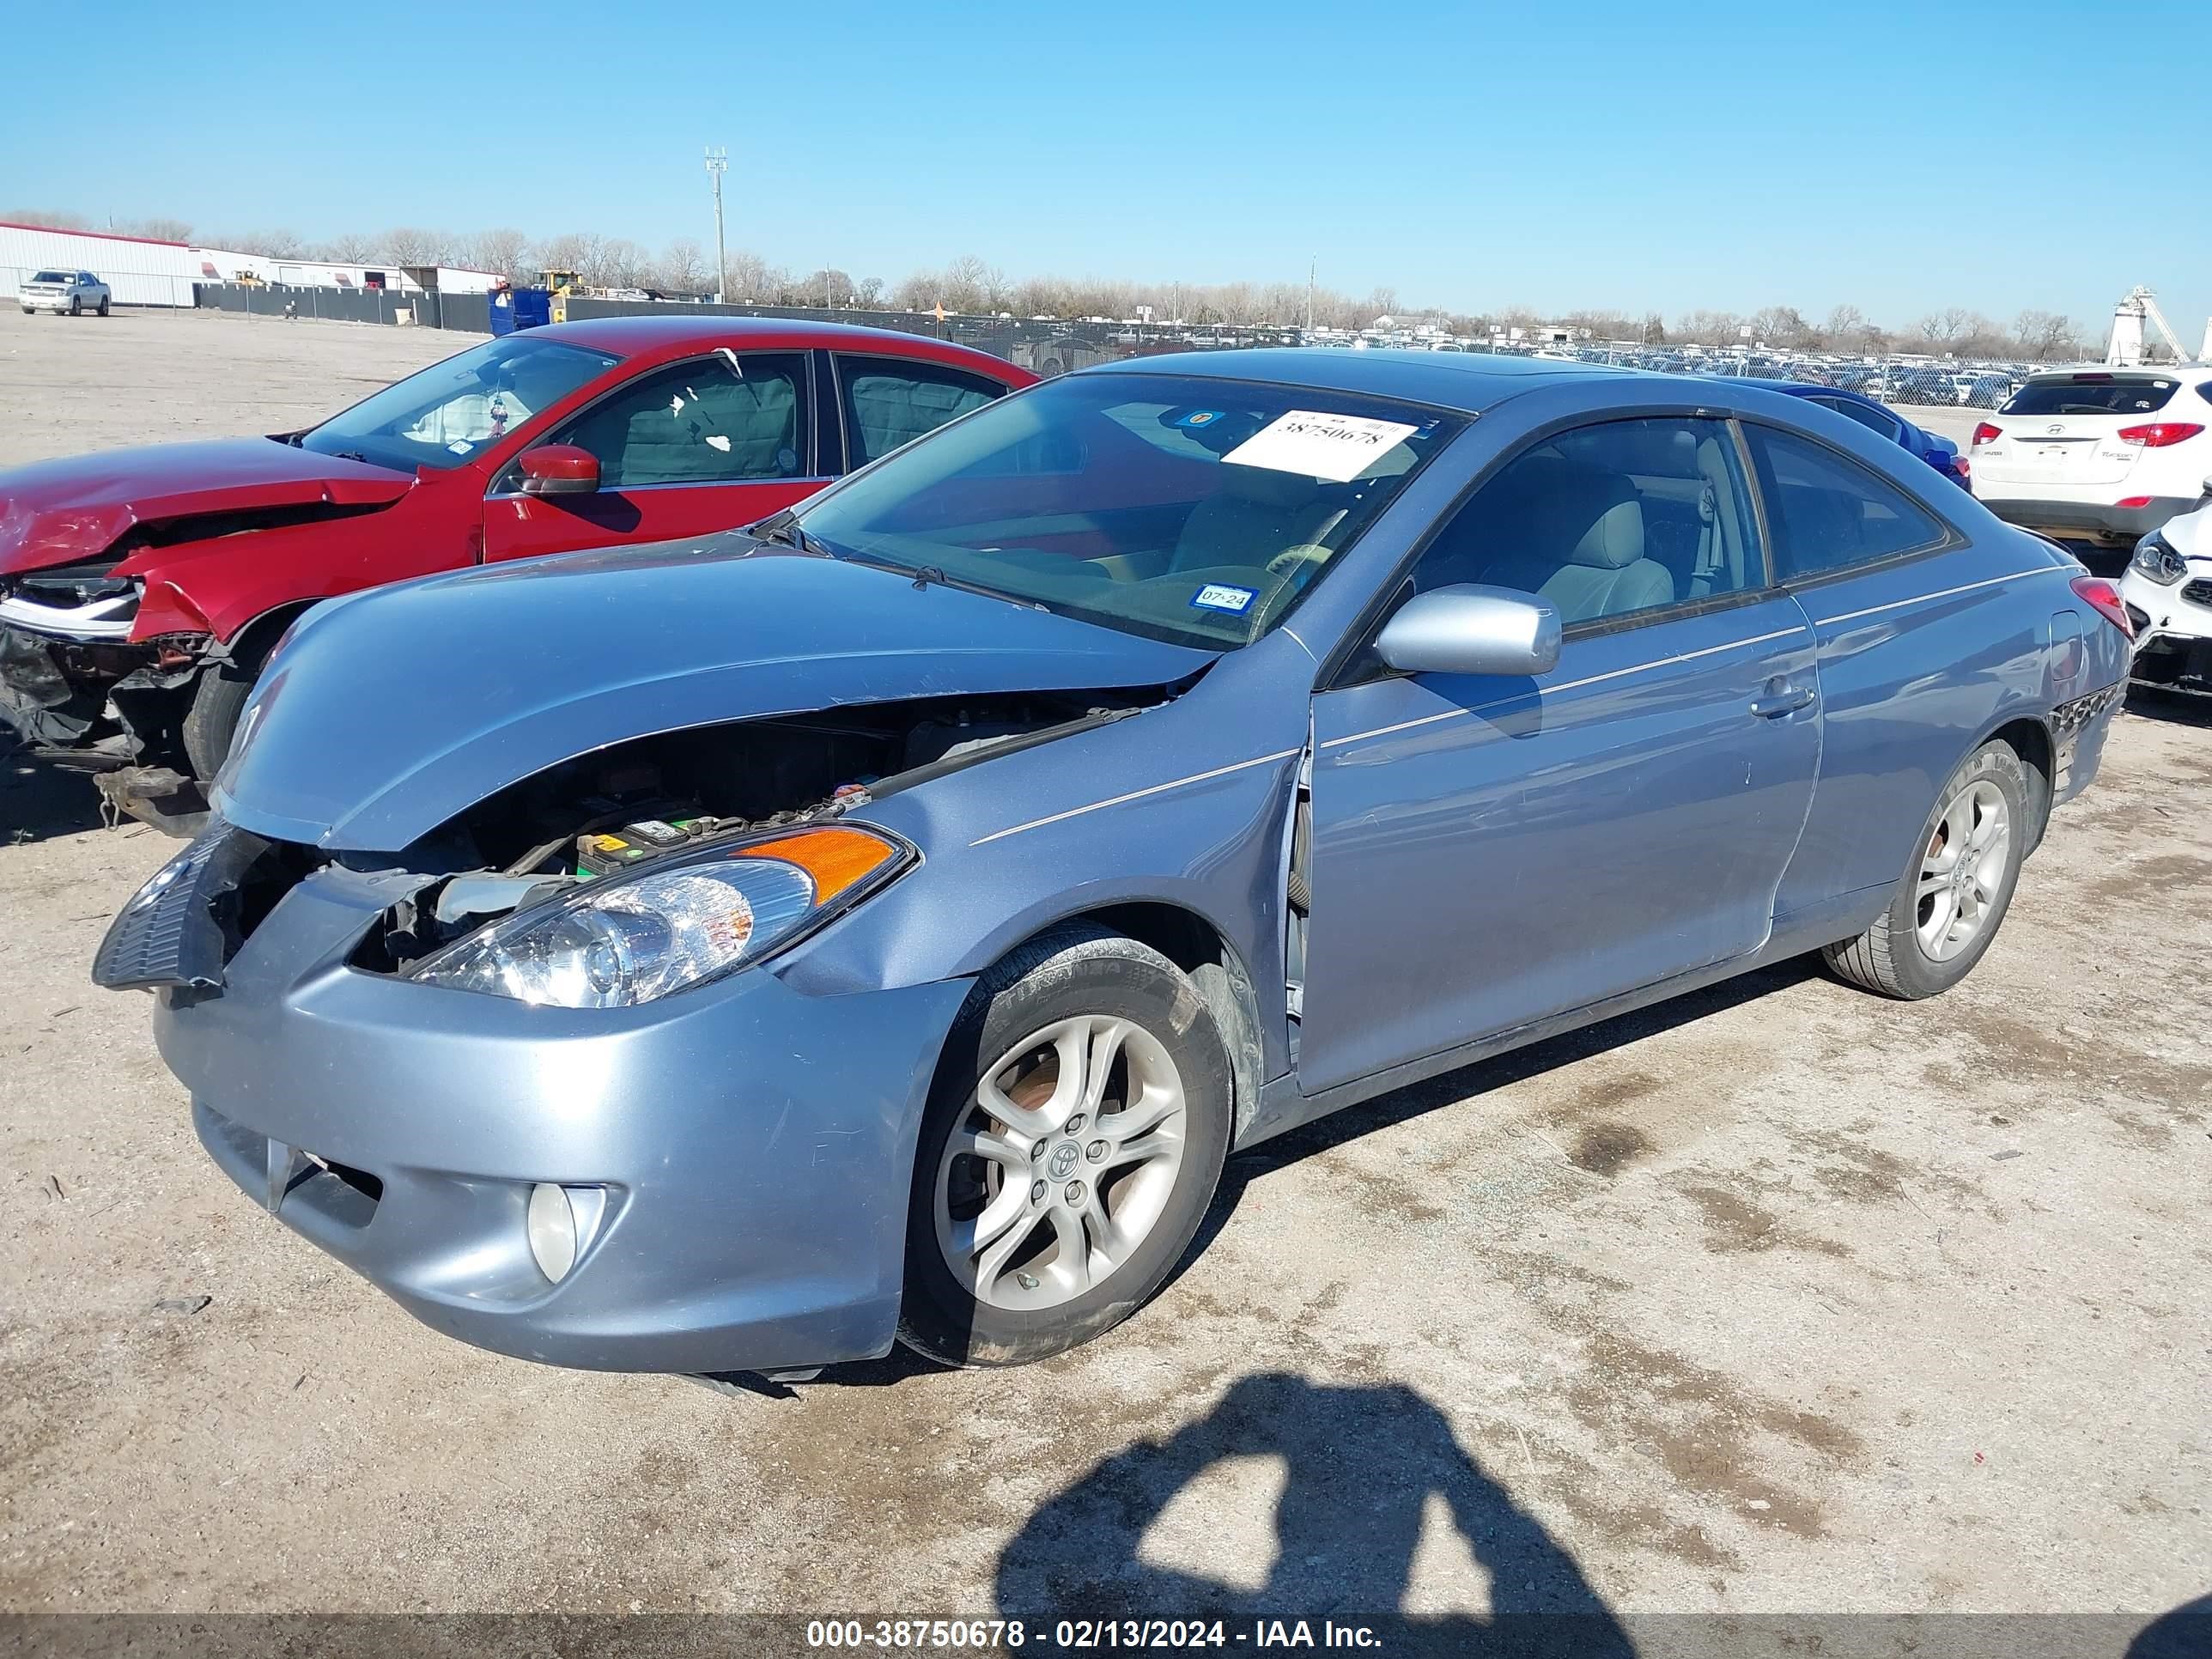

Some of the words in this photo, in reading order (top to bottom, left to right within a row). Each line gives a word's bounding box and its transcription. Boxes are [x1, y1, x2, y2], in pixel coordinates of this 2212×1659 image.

[1277, 422, 1384, 445] 38750678
[1201, 590, 1222, 601] 07
[1225, 594, 1246, 605] 24
